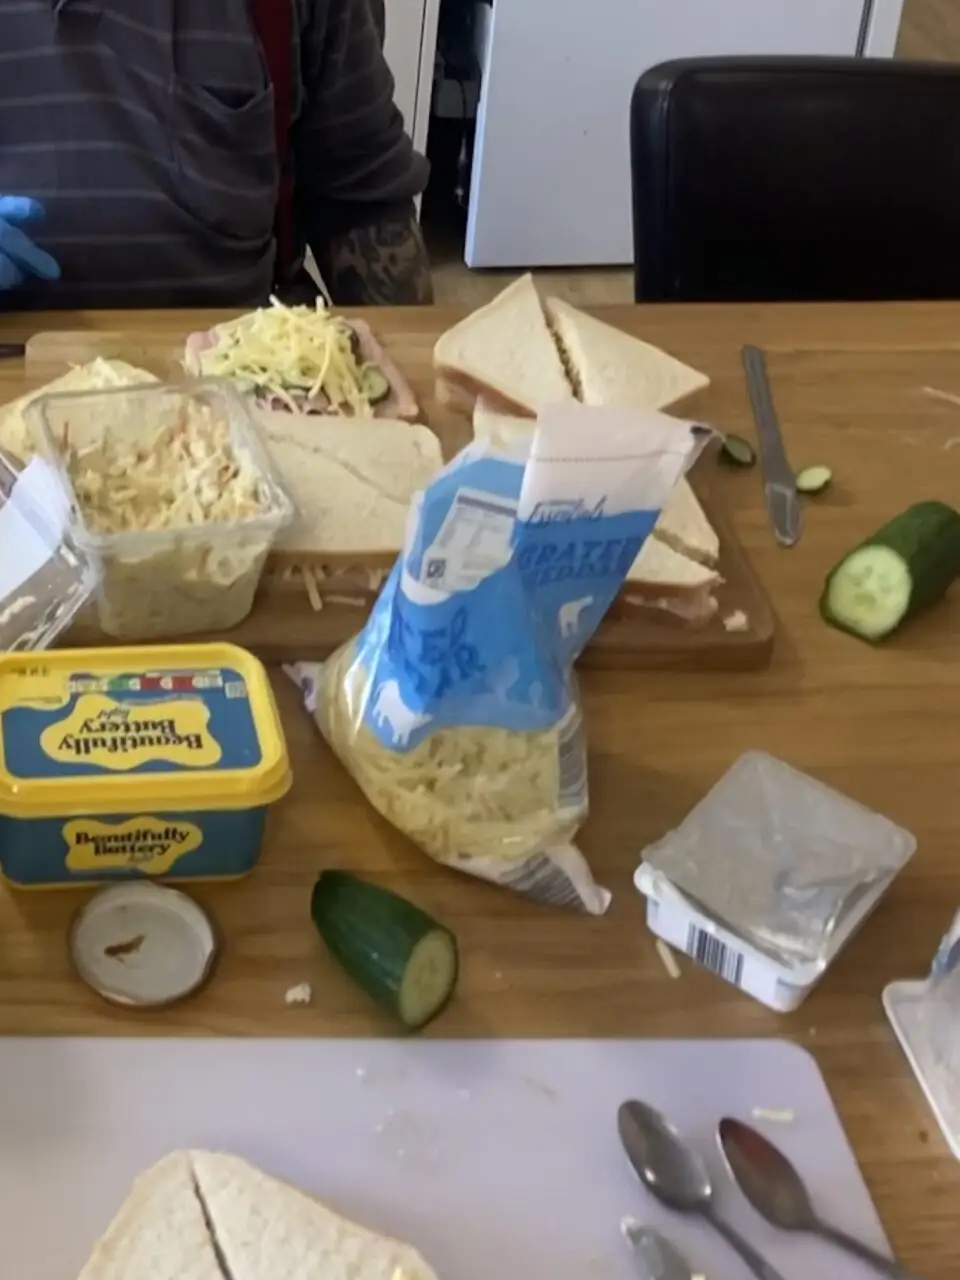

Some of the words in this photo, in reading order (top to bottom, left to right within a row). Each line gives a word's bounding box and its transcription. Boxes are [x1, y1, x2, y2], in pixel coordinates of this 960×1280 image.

[79, 718, 177, 735] Buttery
[58, 731, 204, 755] Beautifully
[75, 827, 189, 844] Beautifully
[94, 842, 171, 856] Buttery
